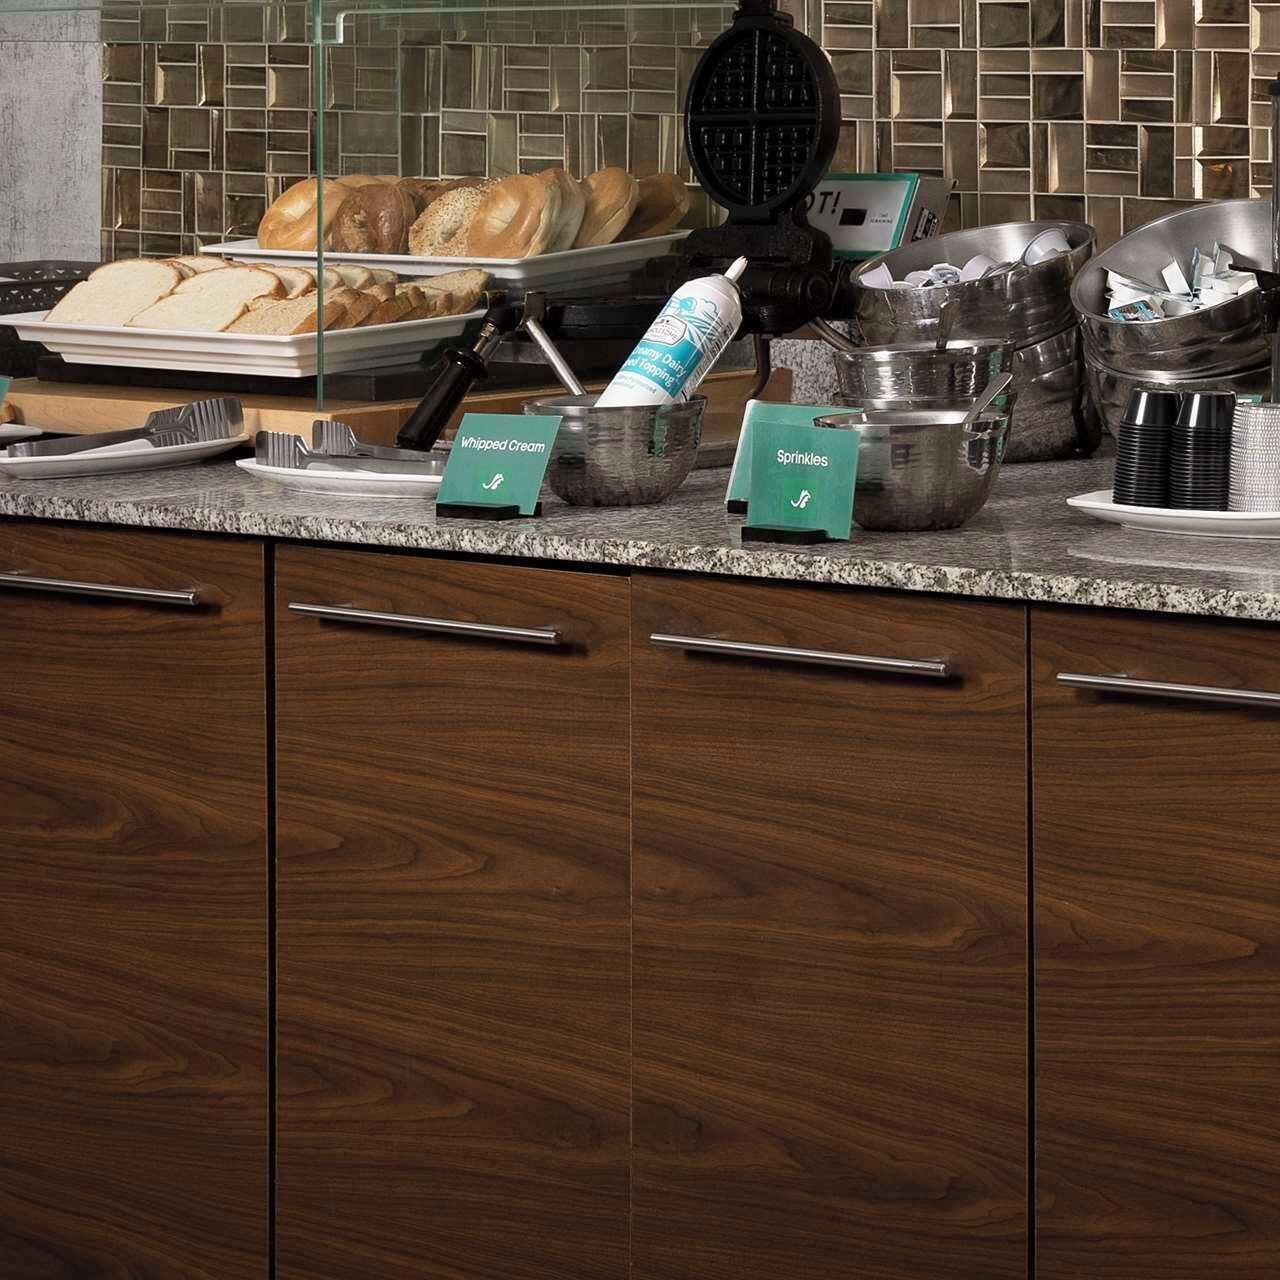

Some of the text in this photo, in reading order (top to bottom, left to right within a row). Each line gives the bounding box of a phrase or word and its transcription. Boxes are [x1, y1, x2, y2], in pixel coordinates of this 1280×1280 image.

[640, 359, 676, 388] Topping
[661, 352, 686, 377] Dairy
[461, 436, 545, 453] Whipped Cream
[777, 449, 829, 467] Sprinkles
